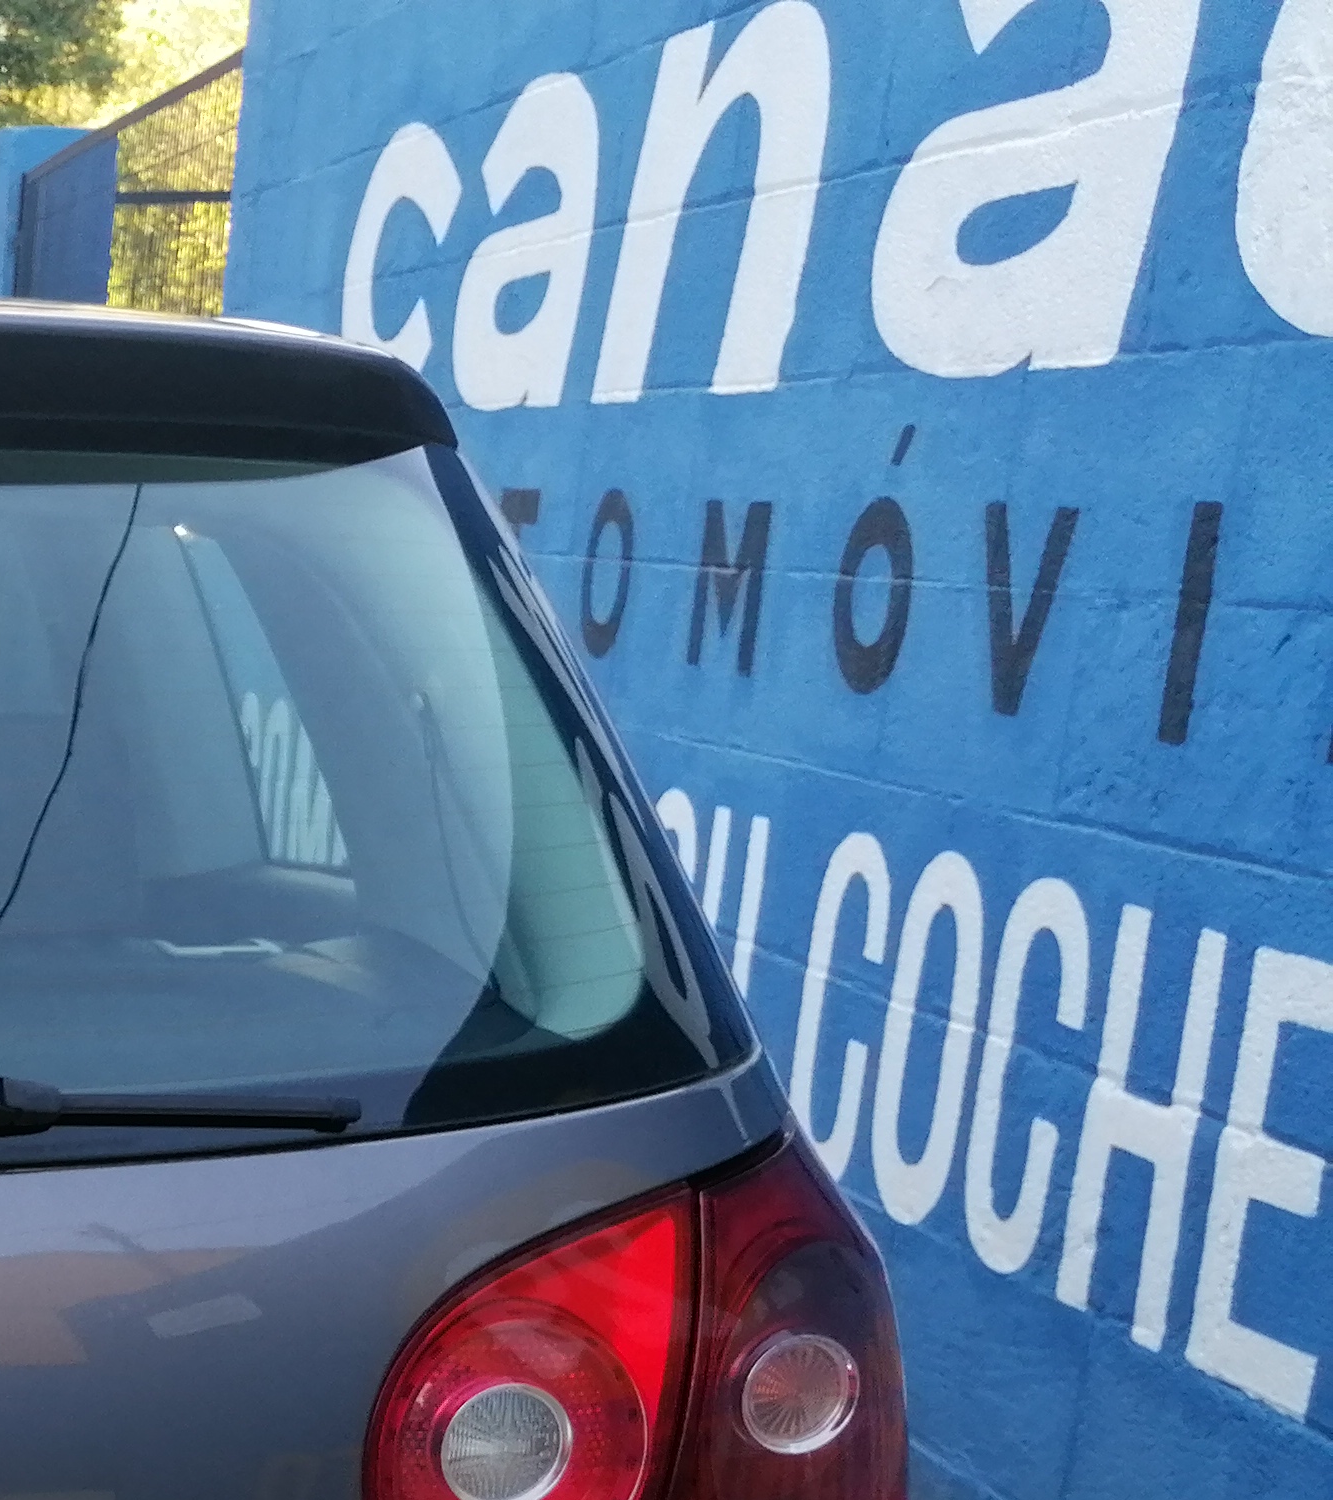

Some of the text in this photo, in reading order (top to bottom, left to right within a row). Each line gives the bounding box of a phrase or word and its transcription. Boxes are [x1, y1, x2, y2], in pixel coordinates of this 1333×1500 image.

[341, 0, 1333, 411] cana
[501, 424, 1333, 764] OMÓVI
[790, 832, 1333, 1424] COCHE
